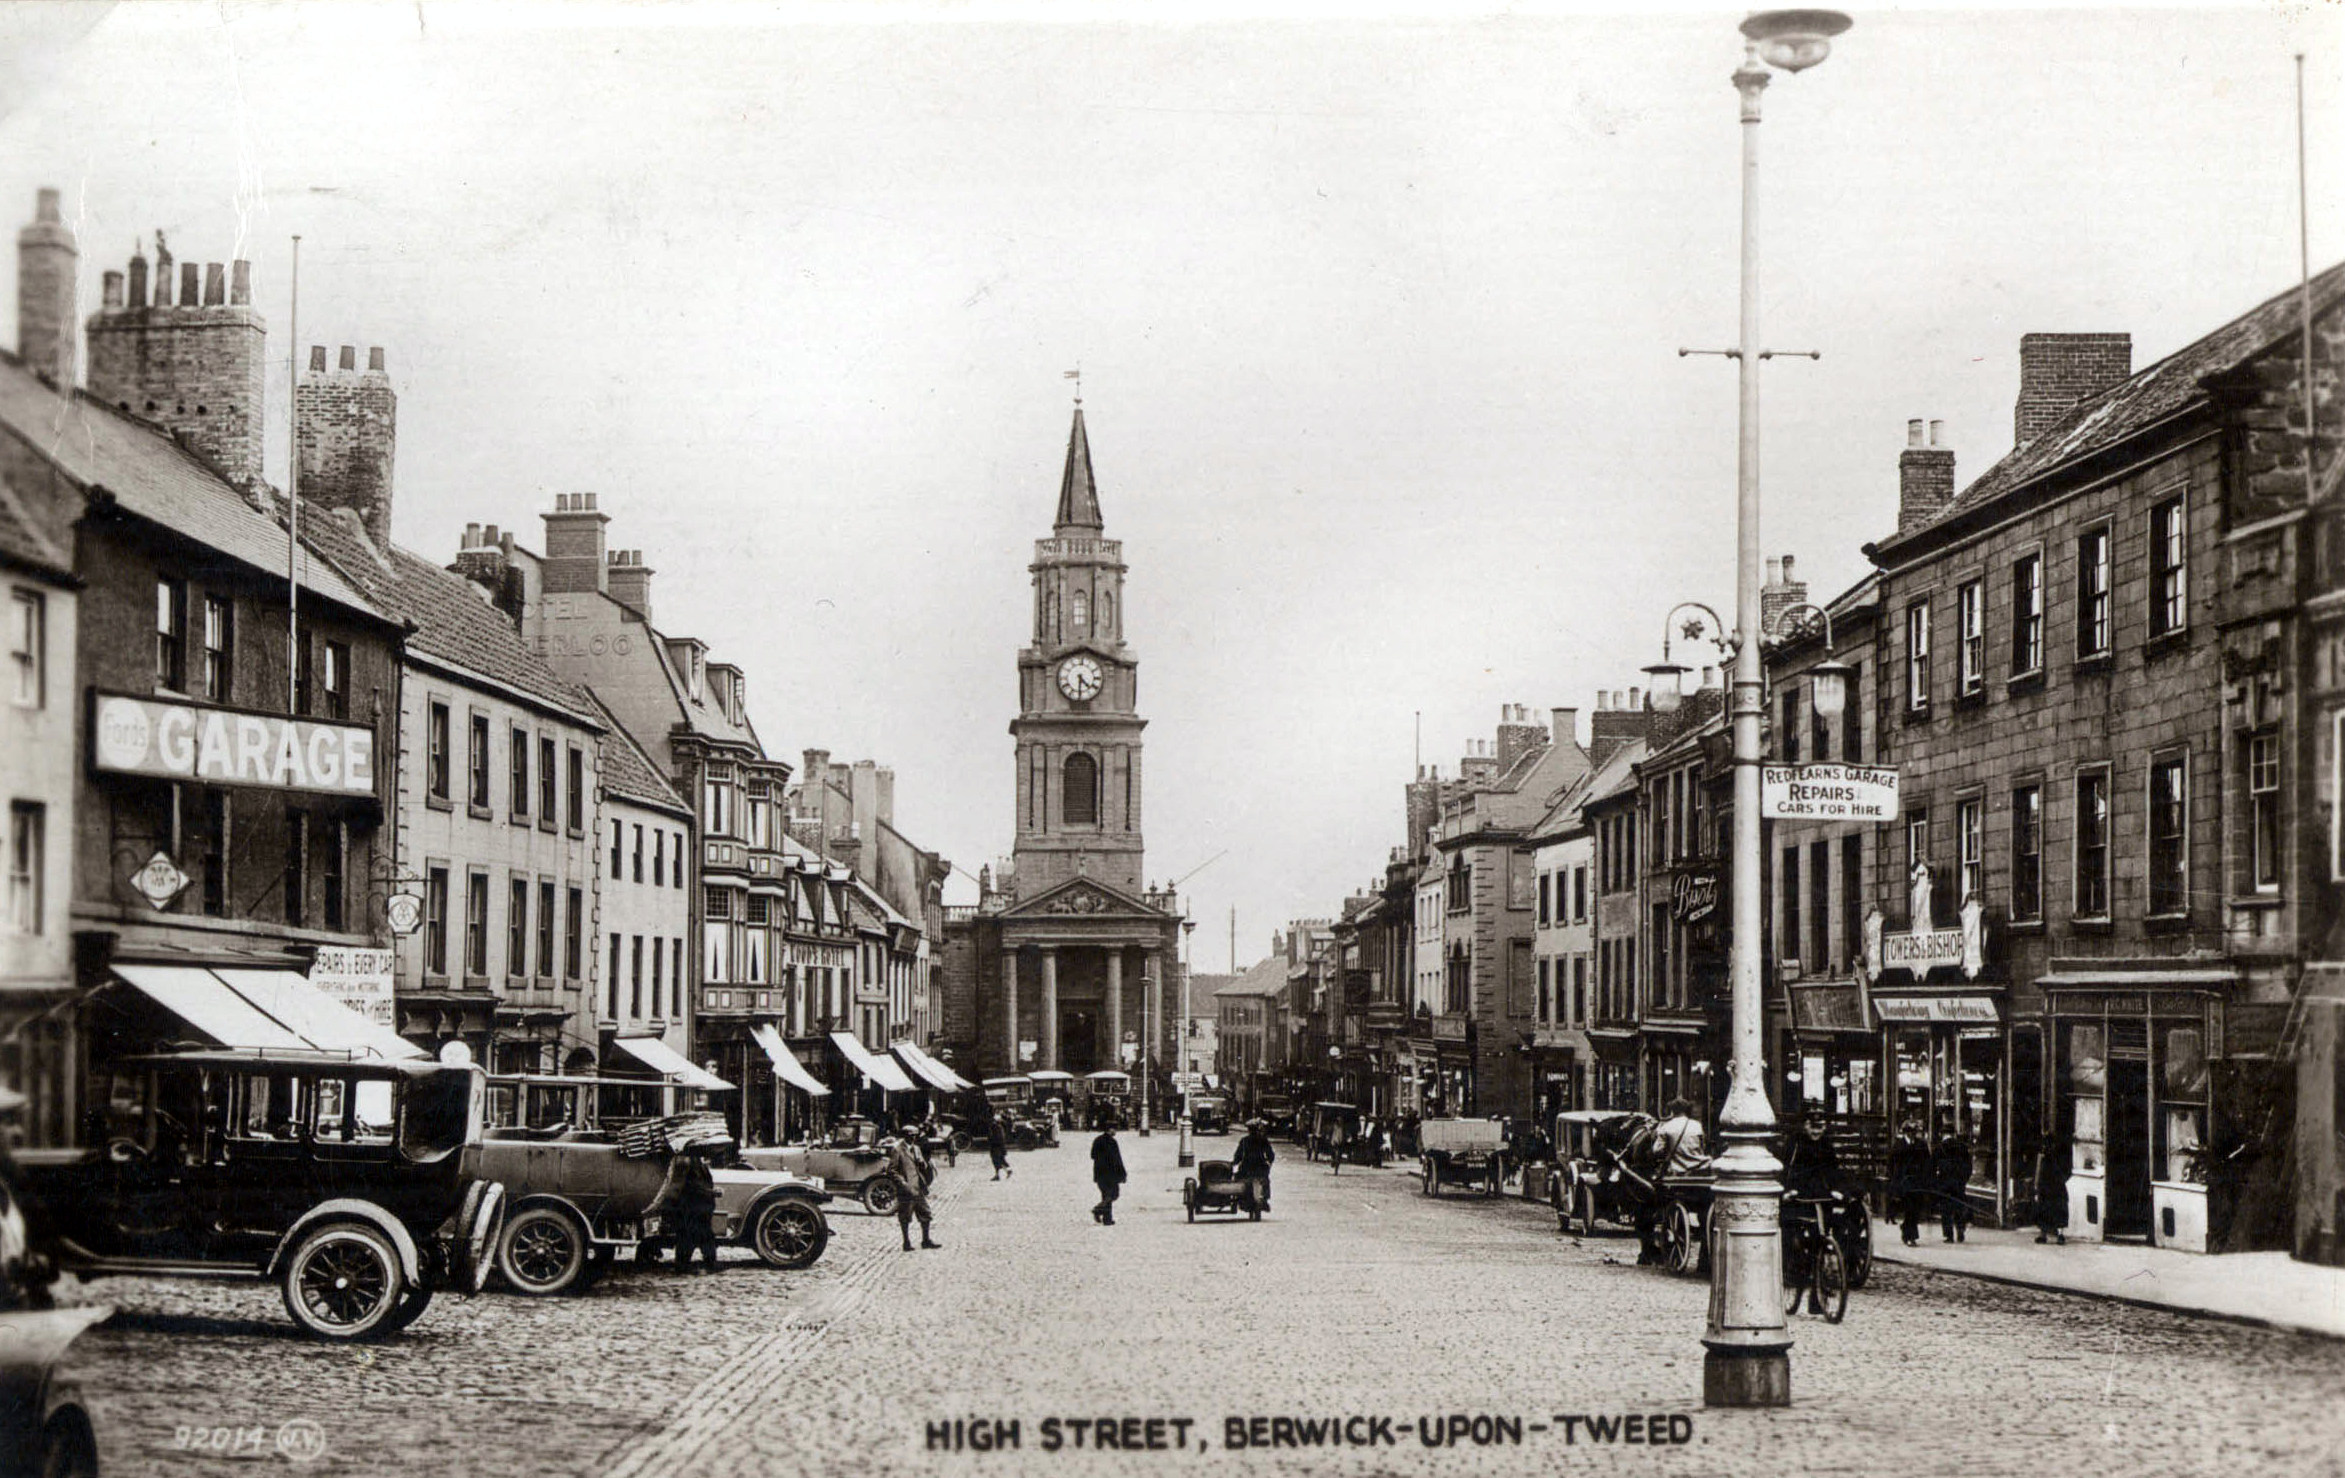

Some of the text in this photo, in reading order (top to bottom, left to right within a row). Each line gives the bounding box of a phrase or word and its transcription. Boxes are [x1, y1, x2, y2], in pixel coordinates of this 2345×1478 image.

[523, 601, 588, 620] OTEL
[522, 635, 632, 656] ERLOO
[158, 705, 374, 790] GARAGE
[1766, 768, 1896, 789] REDFEARNS GARAGE
[1789, 783, 1854, 801] REPAIRS
[1777, 801, 1882, 816] CARS FOR HIRE
[1885, 936, 1920, 961] TOWERS
